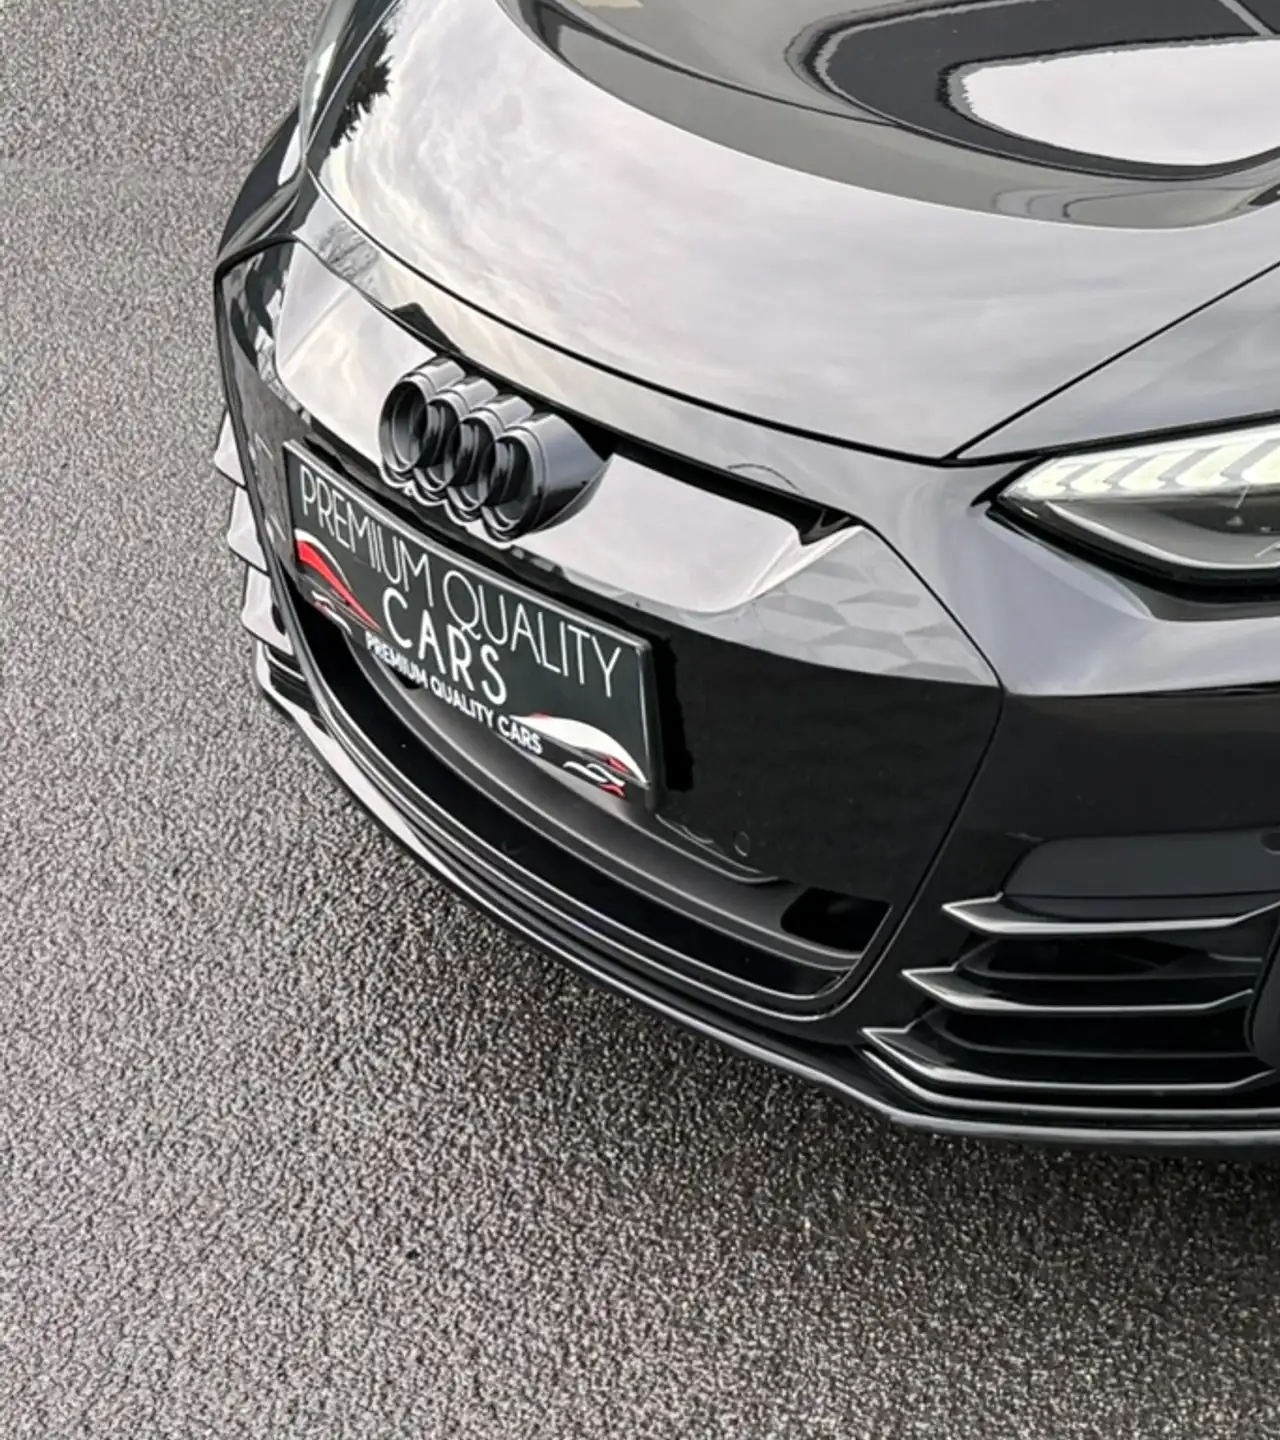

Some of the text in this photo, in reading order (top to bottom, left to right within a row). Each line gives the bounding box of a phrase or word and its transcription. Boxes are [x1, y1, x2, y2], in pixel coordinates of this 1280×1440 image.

[300, 464, 622, 698] PREMIUM QUALITY
[365, 630, 543, 755] PREMIUM QUALITY CARS
[383, 587, 507, 705] CARS
